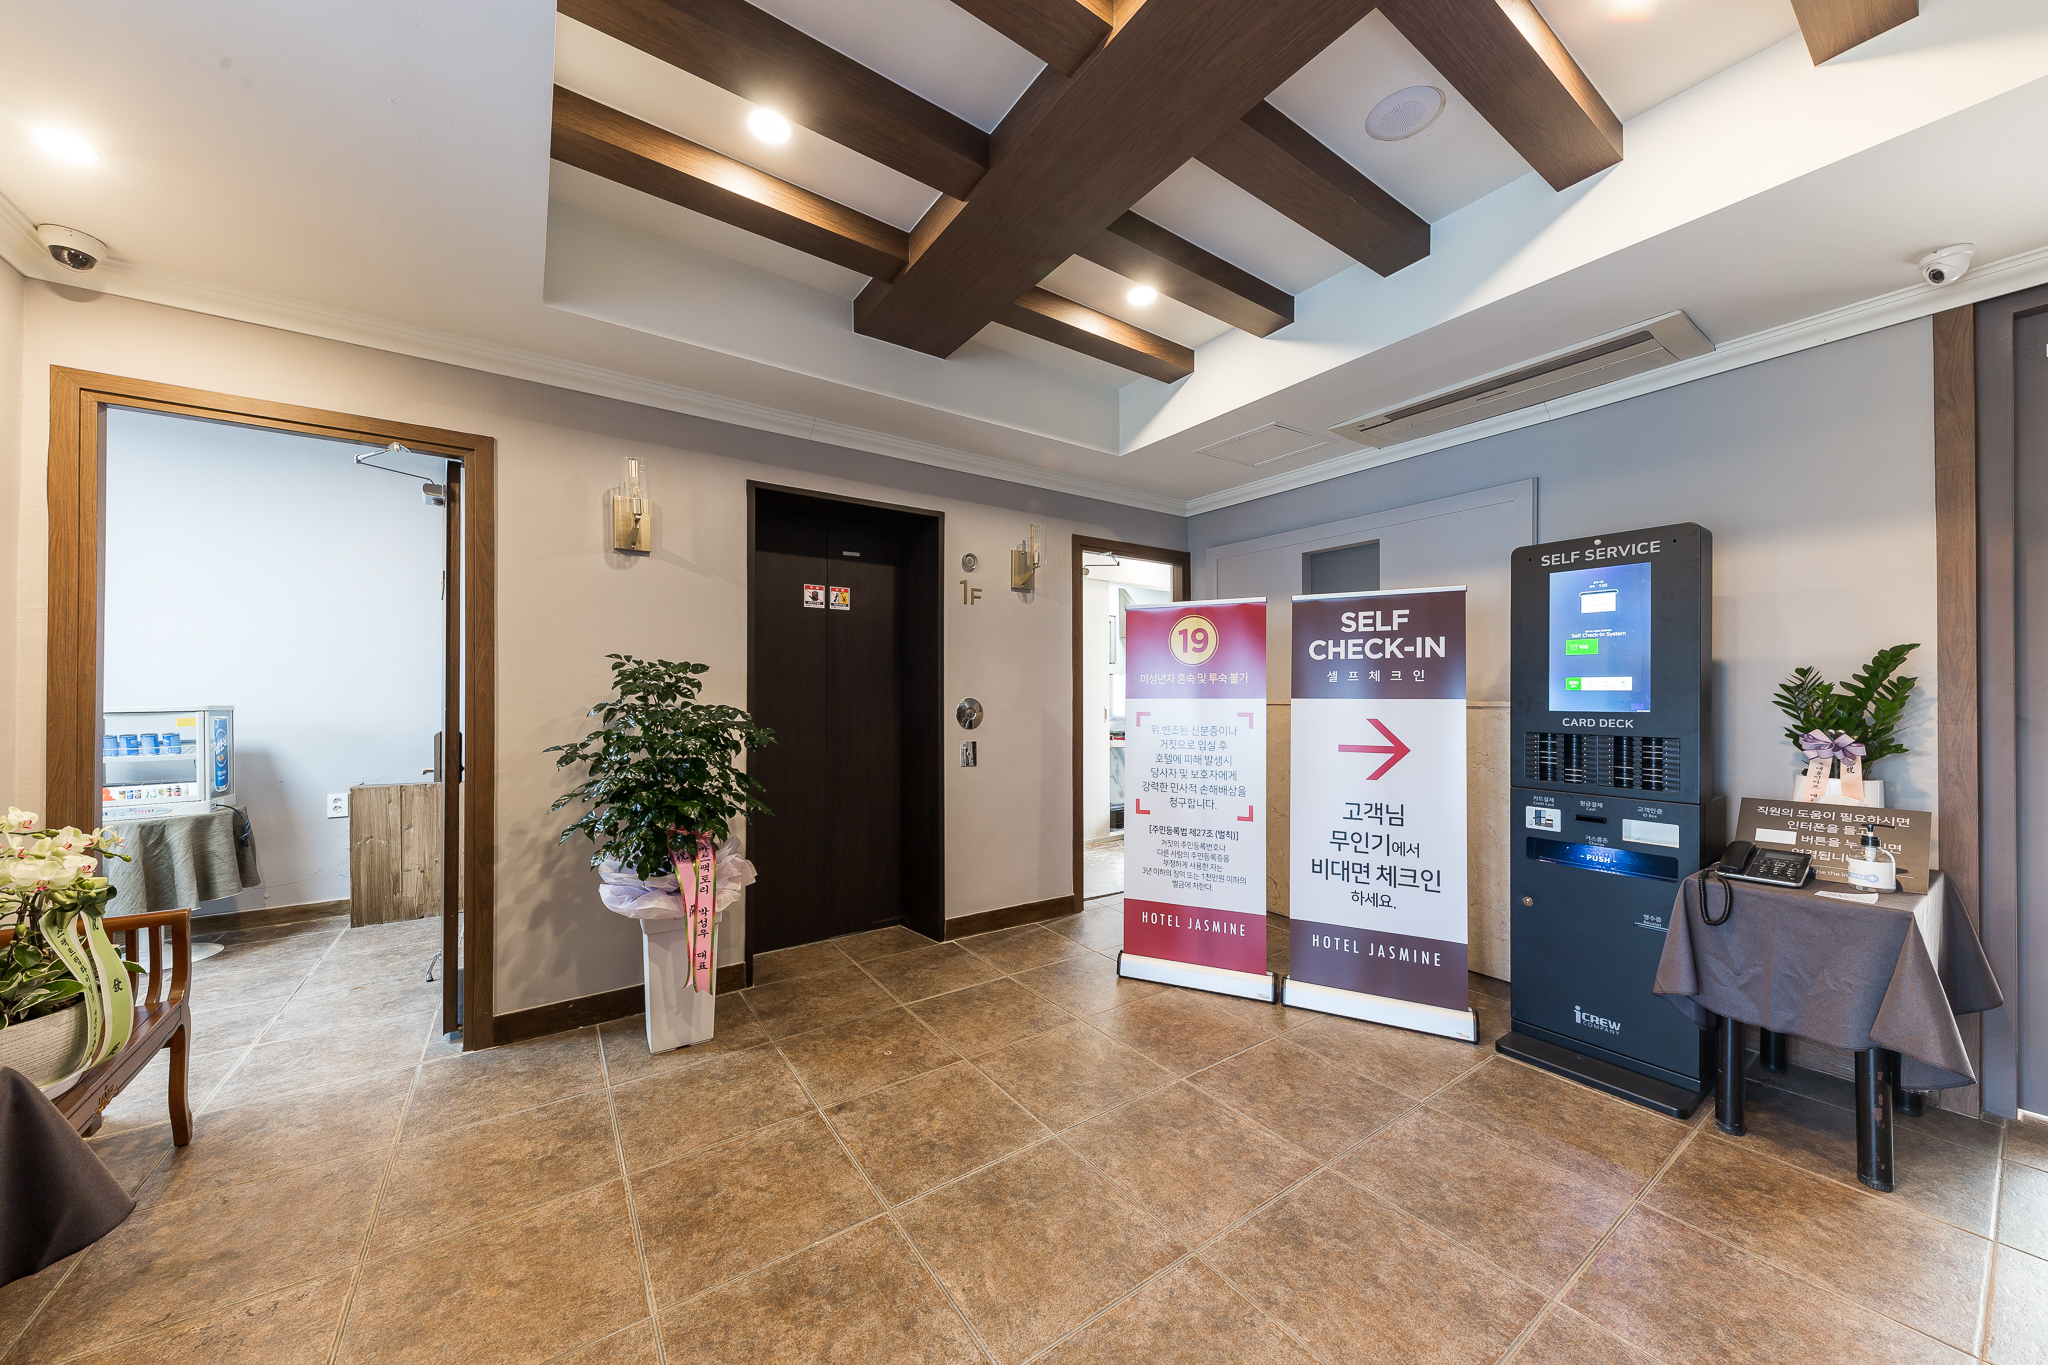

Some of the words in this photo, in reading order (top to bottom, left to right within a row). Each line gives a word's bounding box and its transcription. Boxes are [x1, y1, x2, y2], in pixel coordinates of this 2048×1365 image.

[1541, 551, 1580, 566] SELF
[1585, 540, 1661, 561] SERVICE
[960, 580, 982, 605] 1F
[1340, 609, 1410, 633] SELF
[1178, 628, 1209, 653] 19
[1308, 636, 1446, 660] CHECK-IN
[1140, 673, 1175, 685] 미성년자
[1177, 673, 1195, 685] 혼숙
[1197, 673, 1206, 685] 및
[1209, 672, 1227, 684] 투숙
[1229, 672, 1249, 684] 불가
[1191, 725, 1238, 737] 신분증이나
[1562, 718, 1596, 728] CARD
[1599, 718, 1634, 729] DECK
[1160, 739, 1195, 750] 거짓으로
[1198, 740, 1216, 751] 입실
[1218, 740, 1228, 751] 후
[1155, 753, 1181, 765] 호텔에
[1184, 754, 1202, 765] 피해
[1204, 755, 1232, 767] 발생시
[1151, 767, 1177, 779] 당사자
[1180, 768, 1188, 779] 및
[1190, 769, 1237, 781] 보호자에게
[1142, 781, 1168, 793] 강력한
[1170, 782, 1197, 794] 민사적
[1199, 784, 1247, 797] 손해배상을
[1169, 797, 1217, 810] 청구합니다.
[1343, 802, 1405, 827] 고객님
[1757, 805, 1793, 818] 직원의
[1796, 809, 1835, 821] 도움이
[1840, 812, 1910, 828] 필요하시면
[1149, 825, 1187, 837] [주민등록법
[1189, 828, 1214, 838] 제27조
[1215, 830, 1239, 841] (벌칙)]
[1787, 820, 1838, 834] 인터폰을
[1330, 830, 1420, 858] 무인기에서
[1801, 835, 1841, 848] 버튼을
[1586, 854, 1611, 864] PUSH
[1312, 858, 1370, 885] 비대면
[1376, 865, 1441, 893] 체크인
[1351, 890, 1397, 909] 하세요.
[1142, 911, 1180, 928] HOTEL
[1188, 918, 1246, 937] JASMINE
[1312, 934, 1359, 954] HOTEL
[1369, 943, 1441, 967] JASMINE
[1583, 1021, 1619, 1035] COMPANY
